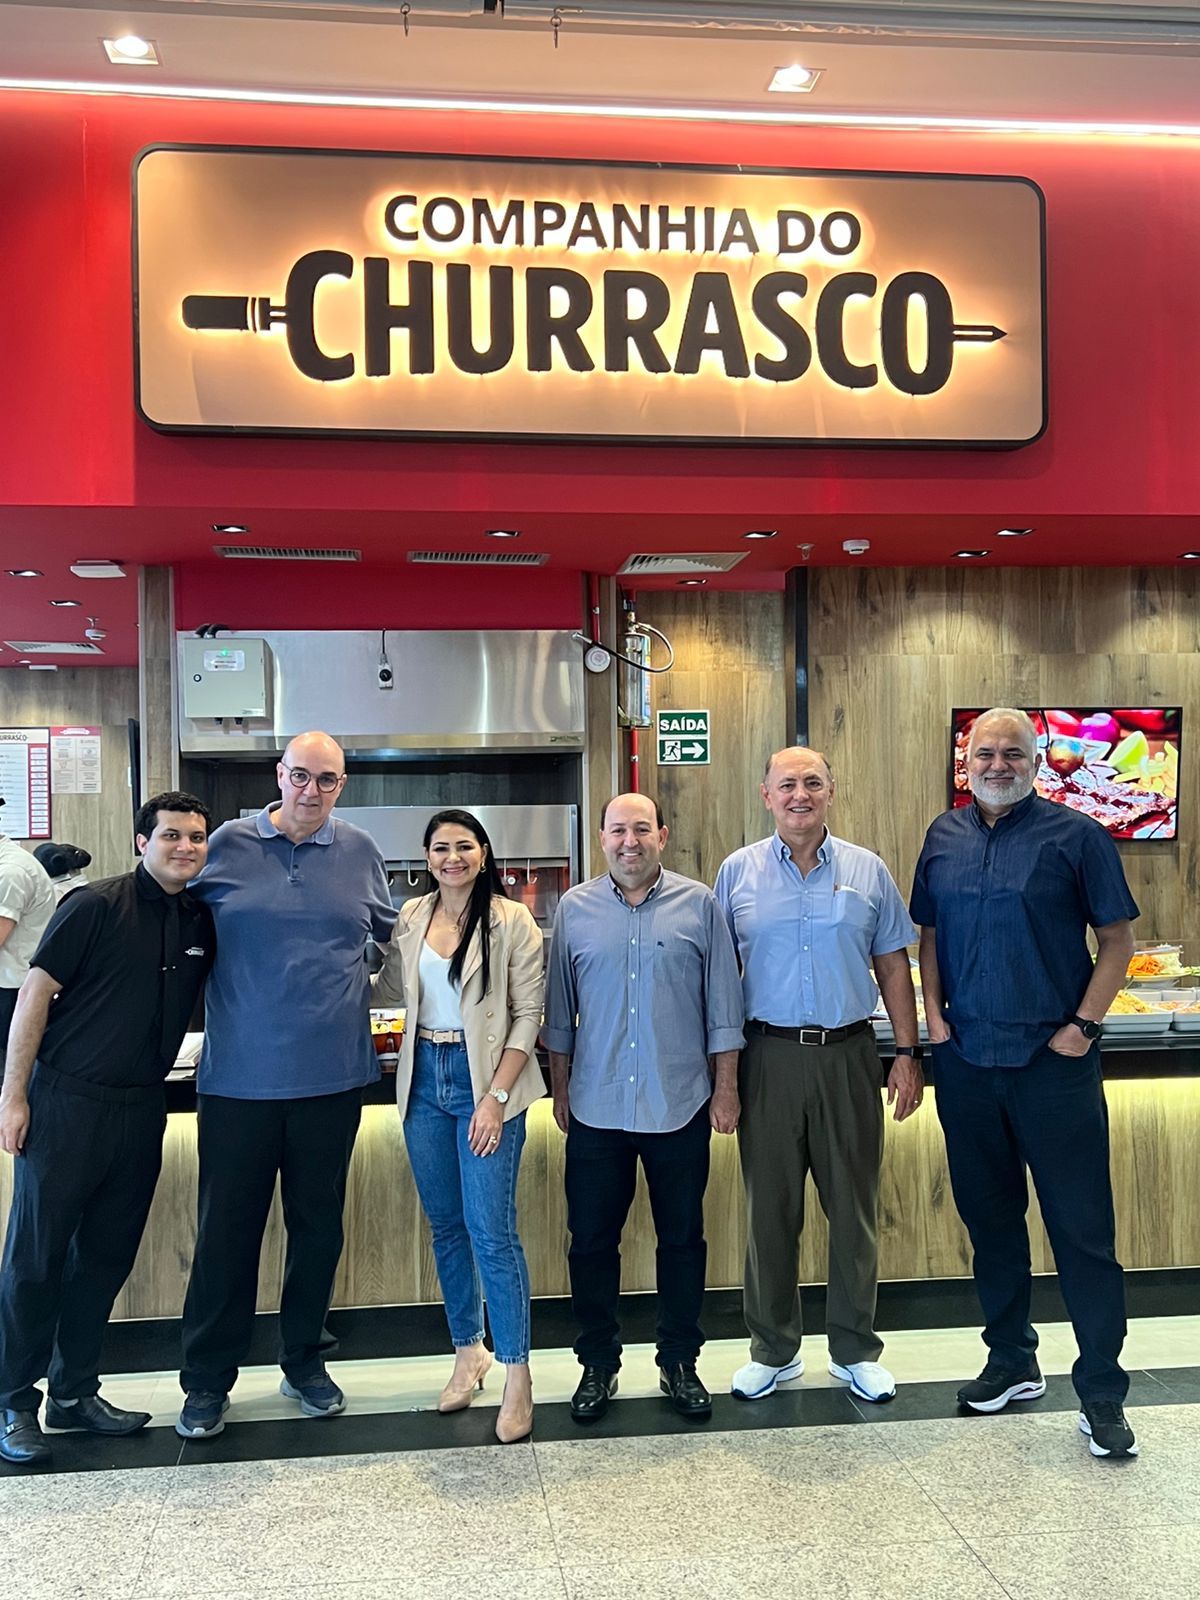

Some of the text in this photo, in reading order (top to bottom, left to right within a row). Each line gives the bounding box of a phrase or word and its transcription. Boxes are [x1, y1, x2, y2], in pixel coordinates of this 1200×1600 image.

[385, 195, 861, 256] COMPANHIA DO
[286, 250, 953, 395] CHURRASCO
[660, 716, 707, 731] SAÍDA
